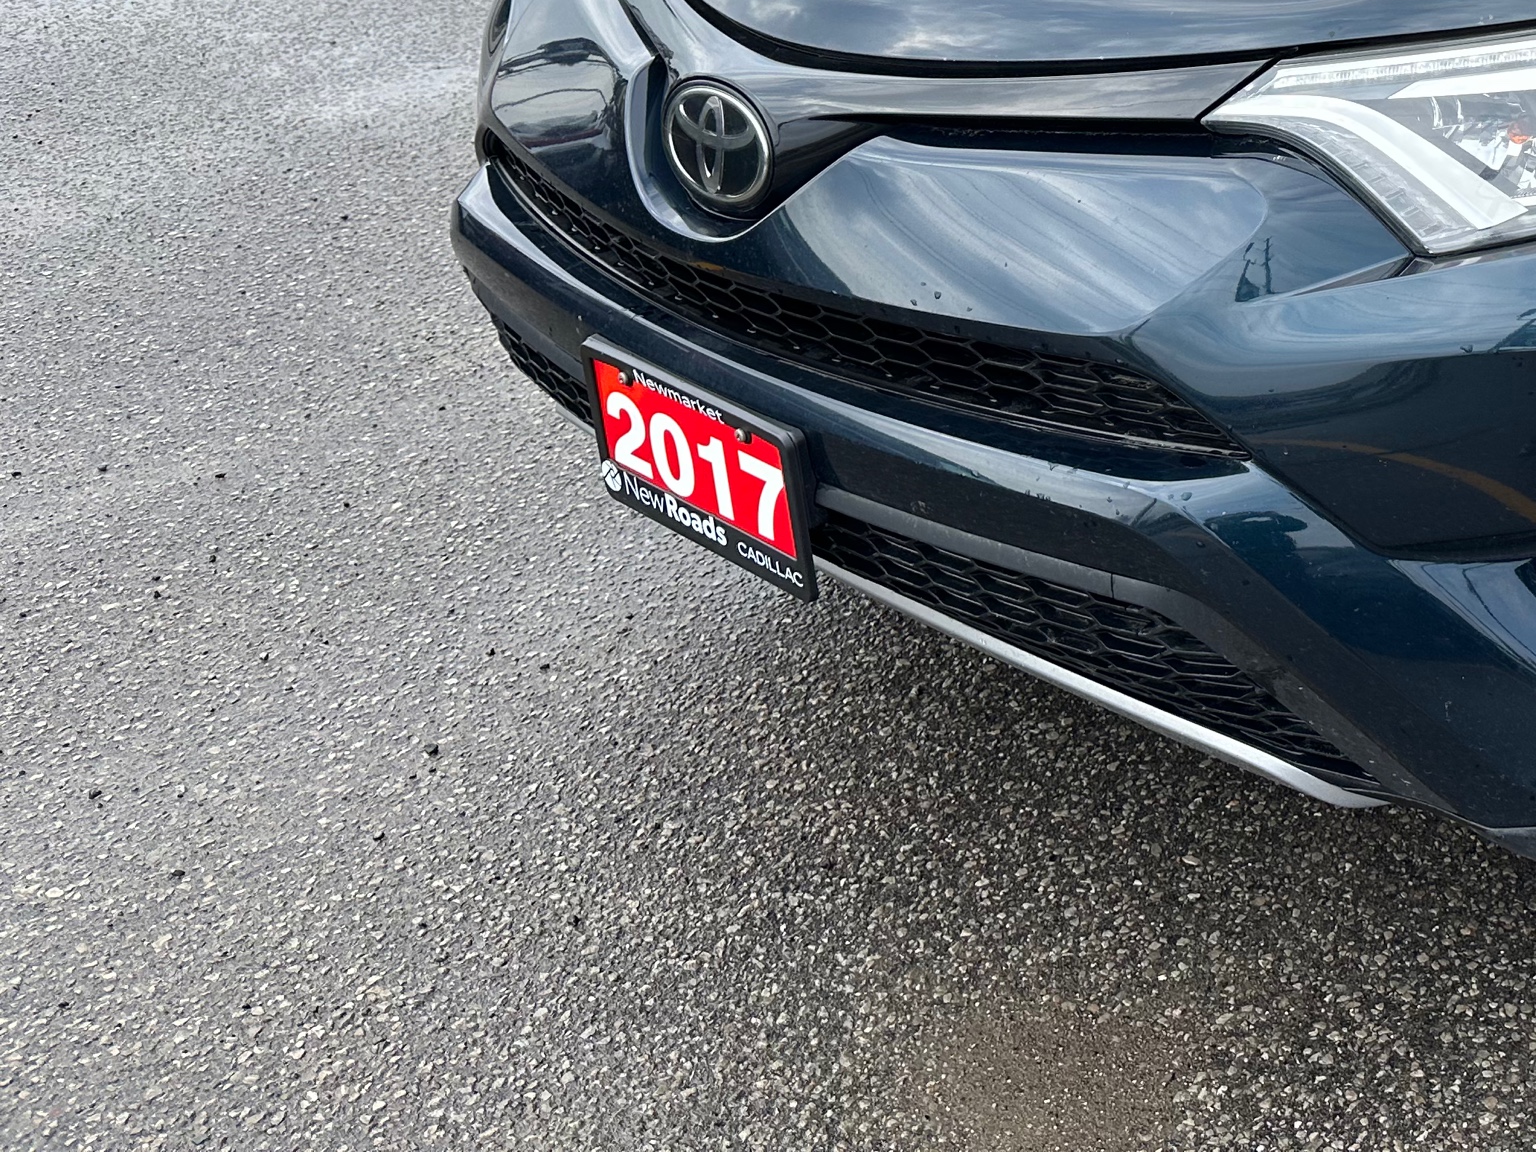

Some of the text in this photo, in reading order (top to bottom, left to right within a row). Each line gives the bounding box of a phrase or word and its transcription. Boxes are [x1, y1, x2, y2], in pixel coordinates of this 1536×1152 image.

[632, 368, 725, 425] Newmarket
[606, 391, 784, 541] 2017
[624, 472, 804, 588] NewRoads CADILLAC
